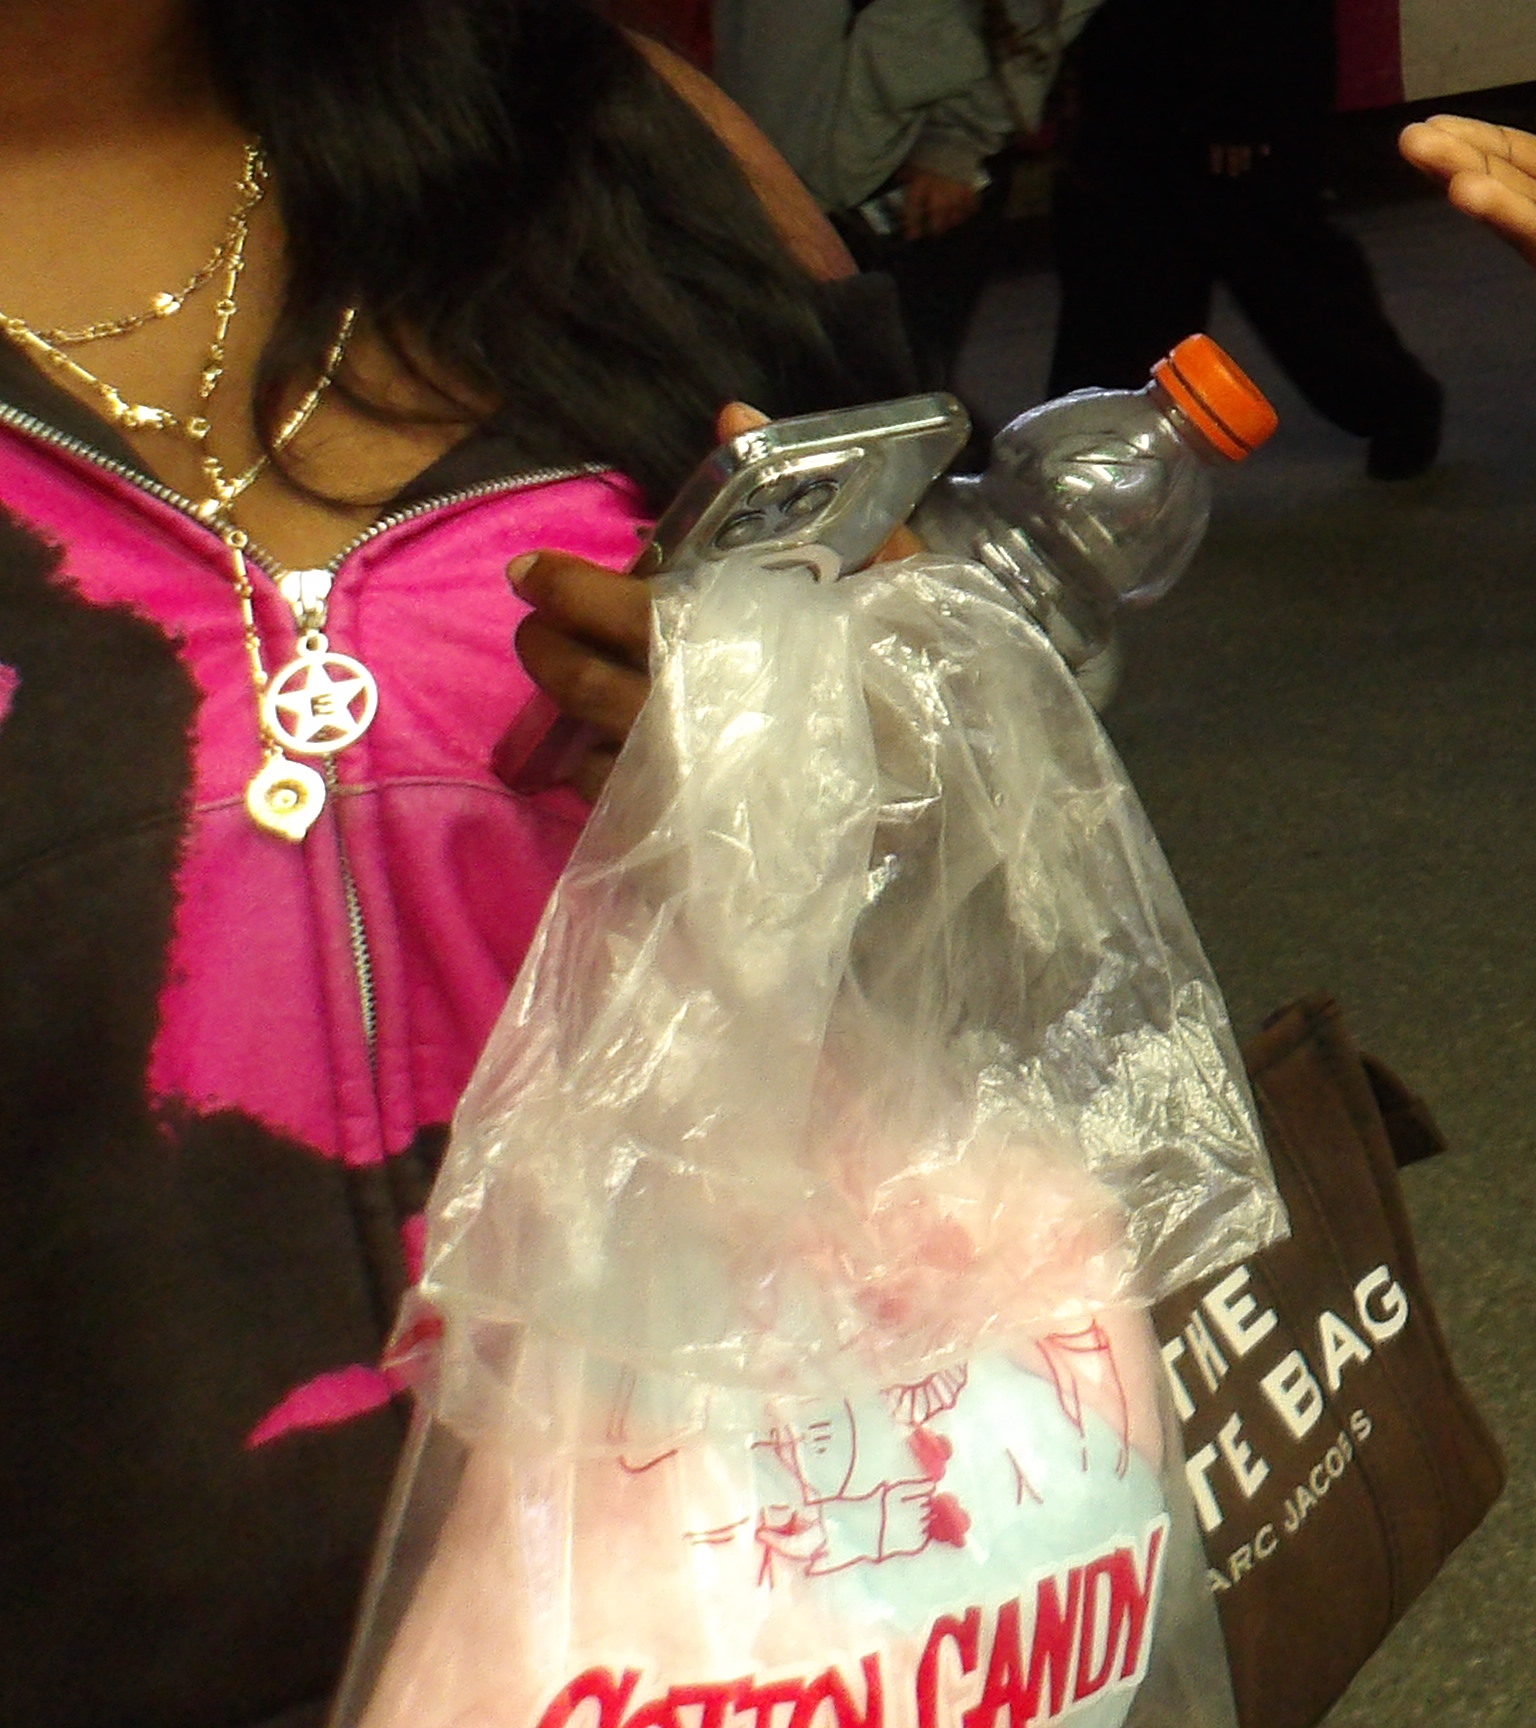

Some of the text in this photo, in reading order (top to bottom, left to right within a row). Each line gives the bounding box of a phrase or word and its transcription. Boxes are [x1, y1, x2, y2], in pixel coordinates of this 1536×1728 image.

[1160, 1263, 1279, 1422] THE
[1186, 1263, 1410, 1533] TE BAG
[916, 1524, 1164, 1728] CANDY
[1207, 1523, 1279, 1593] ARC
